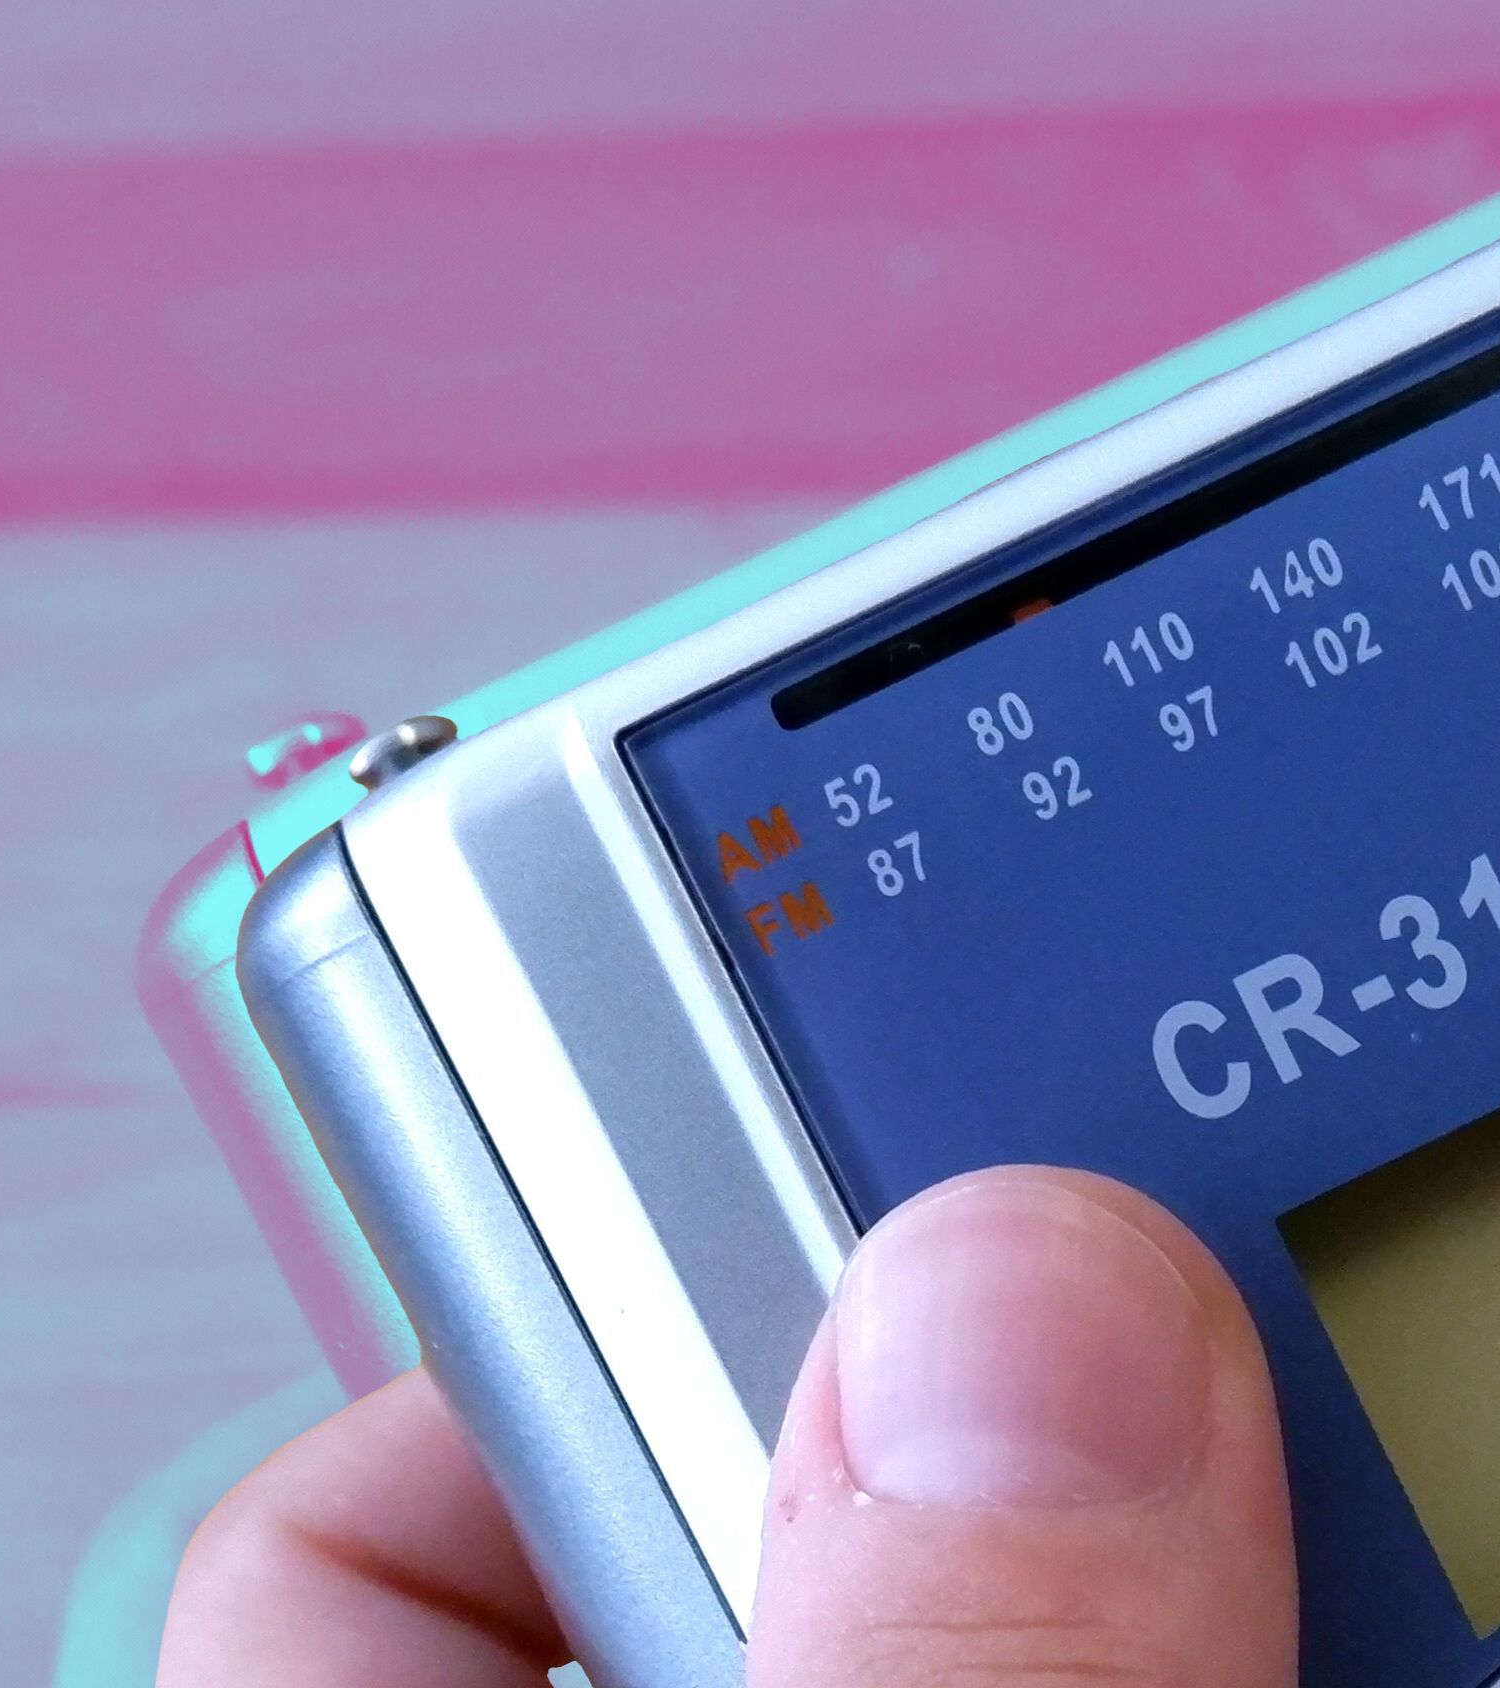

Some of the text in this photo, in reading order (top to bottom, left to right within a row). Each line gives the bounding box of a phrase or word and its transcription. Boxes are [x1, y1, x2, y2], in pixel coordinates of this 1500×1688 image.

[717, 806, 801, 882] AM
[823, 763, 894, 827] 52
[967, 692, 1034, 756] 80
[1103, 612, 1194, 687] 110
[1249, 538, 1343, 614] 140
[745, 883, 833, 954] FM
[867, 831, 926, 897] 87
[1022, 756, 1093, 820] 92
[1159, 685, 1218, 752] 97
[1285, 612, 1383, 688] 102
